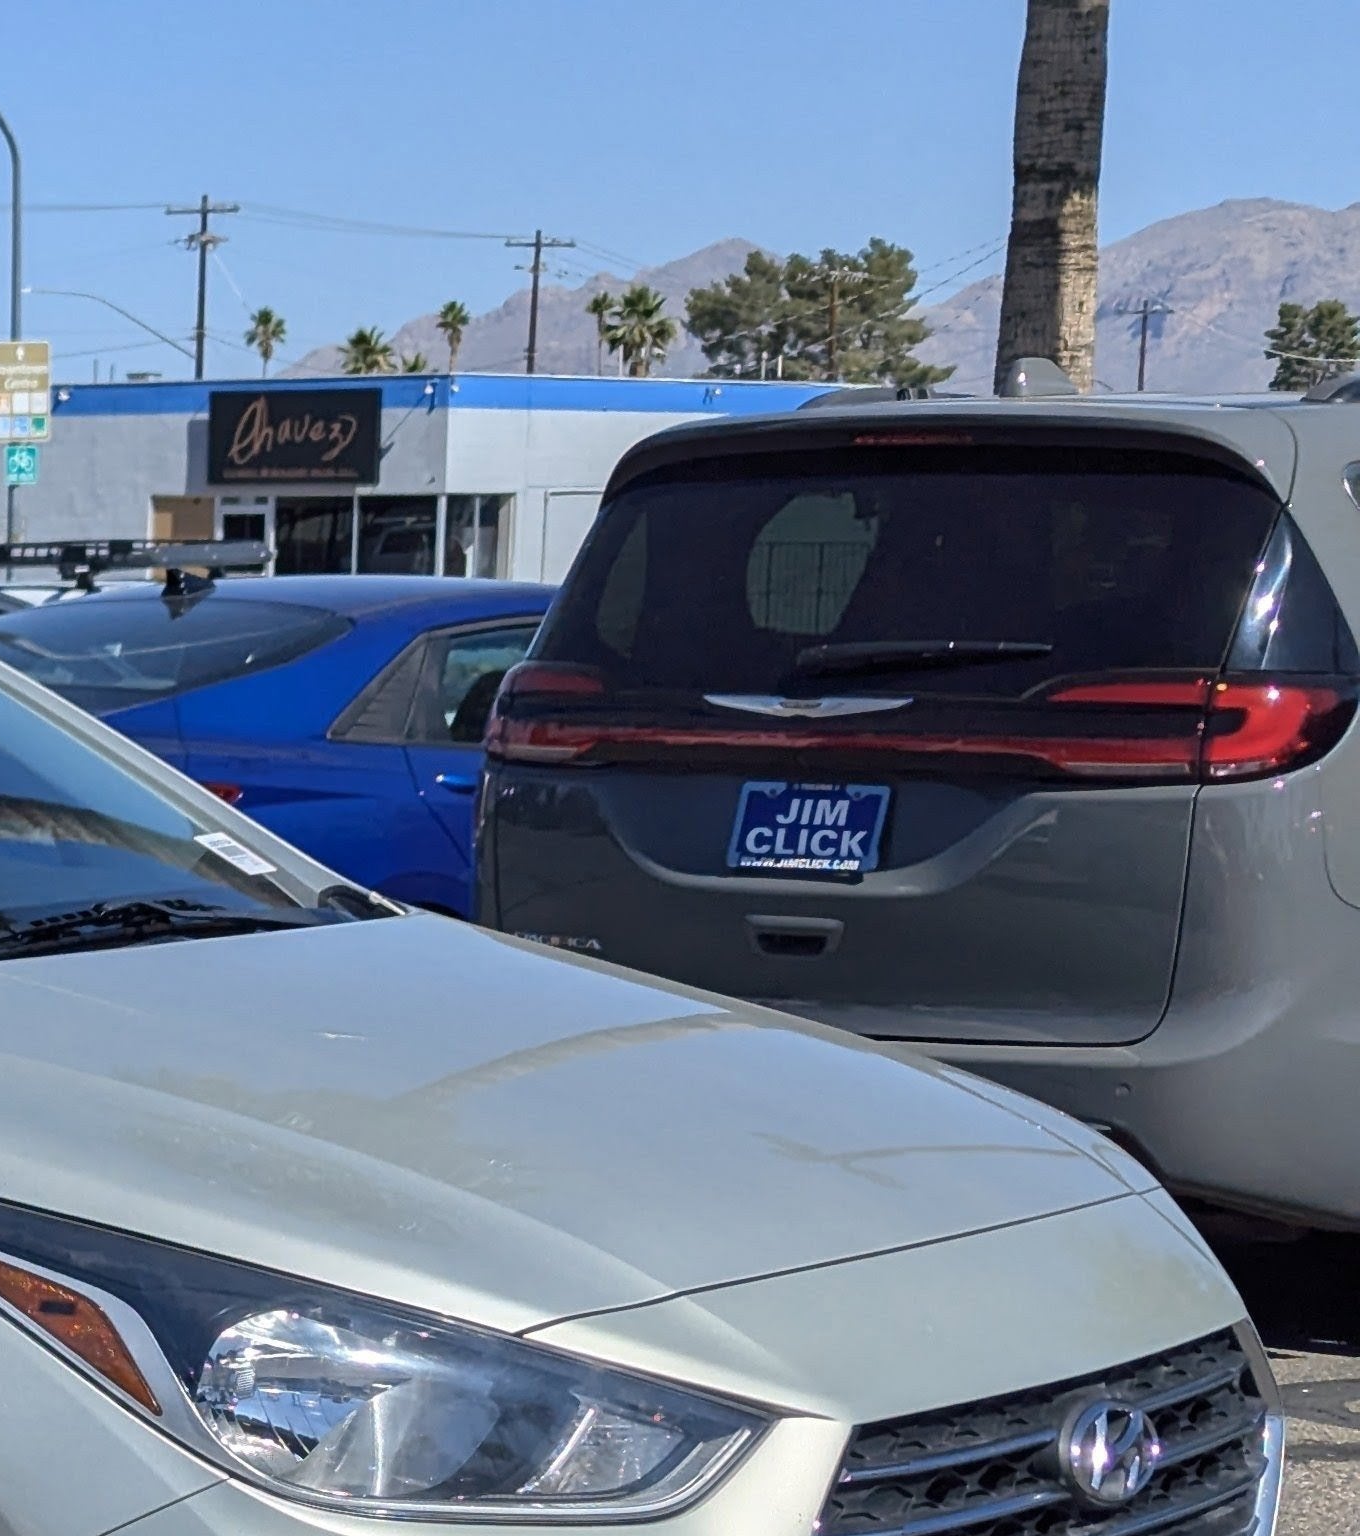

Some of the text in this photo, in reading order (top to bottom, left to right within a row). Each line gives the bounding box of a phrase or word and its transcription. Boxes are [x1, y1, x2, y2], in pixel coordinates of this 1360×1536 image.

[228, 395, 358, 465] Chavez
[775, 798, 850, 827] JIM
[745, 827, 868, 858] CLICK
